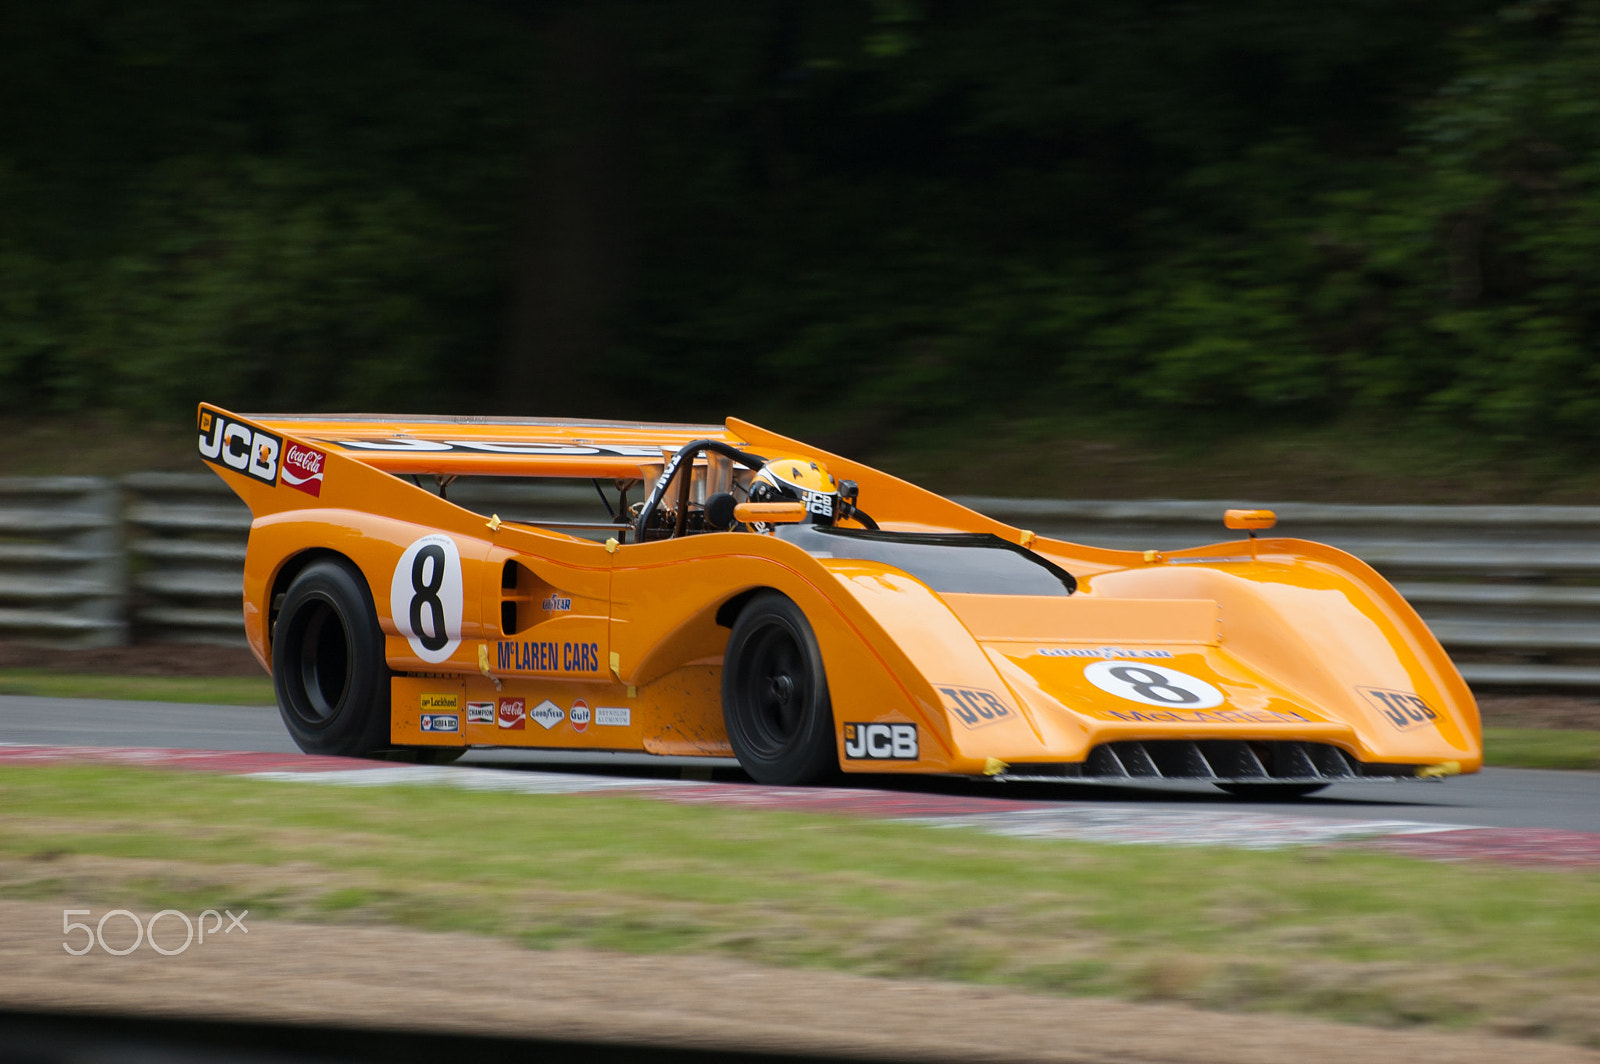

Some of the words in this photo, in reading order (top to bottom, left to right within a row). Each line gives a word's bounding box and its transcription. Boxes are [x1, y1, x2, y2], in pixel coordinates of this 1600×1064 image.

[199, 417, 279, 481] JCB
[801, 491, 832, 506] JCB
[409, 544, 449, 651] 8
[563, 642, 599, 672] CARS
[1109, 666, 1201, 704] 8
[469, 708, 493, 717] CHAMPION
[570, 709, 589, 721] Gulf
[939, 687, 1009, 725] JCB
[1367, 690, 1437, 727] JCB
[846, 724, 918, 758] JCB
